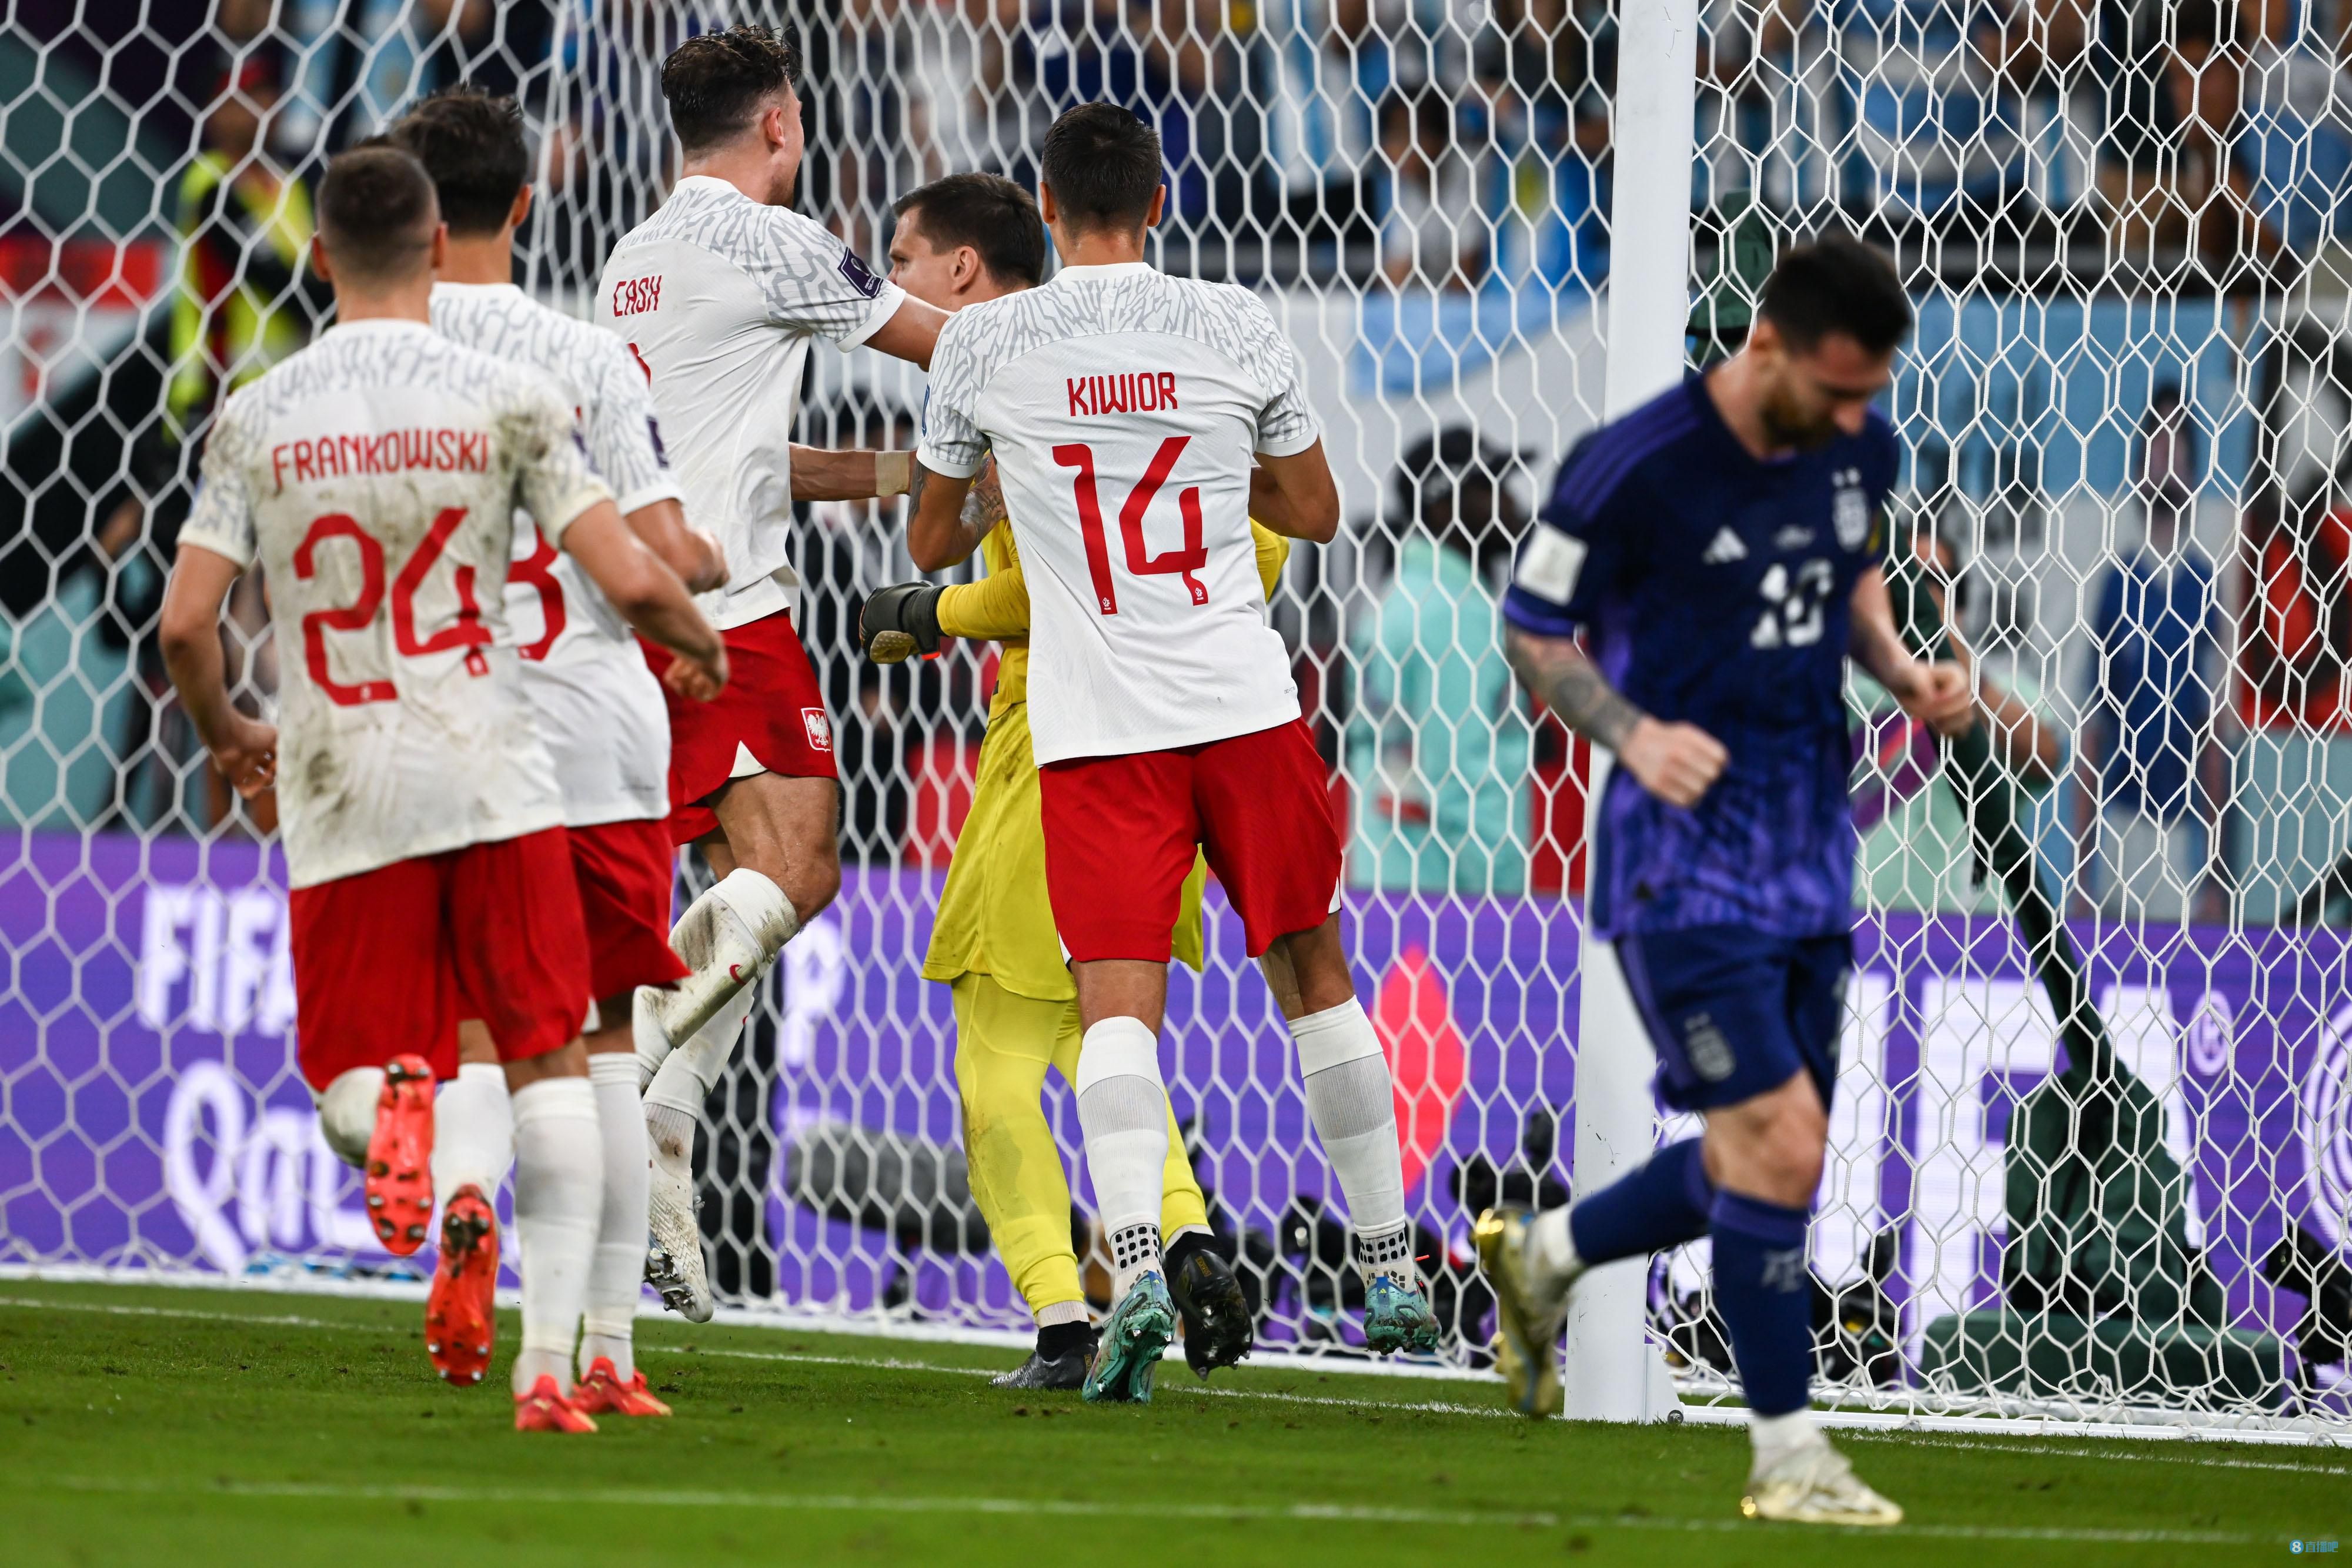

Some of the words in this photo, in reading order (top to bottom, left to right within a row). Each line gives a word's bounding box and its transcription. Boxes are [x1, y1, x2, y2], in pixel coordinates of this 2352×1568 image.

[613, 275, 662, 317] CASH
[1067, 372, 1178, 417] KIWIOR
[272, 428, 489, 492] FRANKOWSKI
[1051, 435, 1209, 616] 14
[292, 507, 493, 707] 24
[1750, 559, 1835, 648] 10
